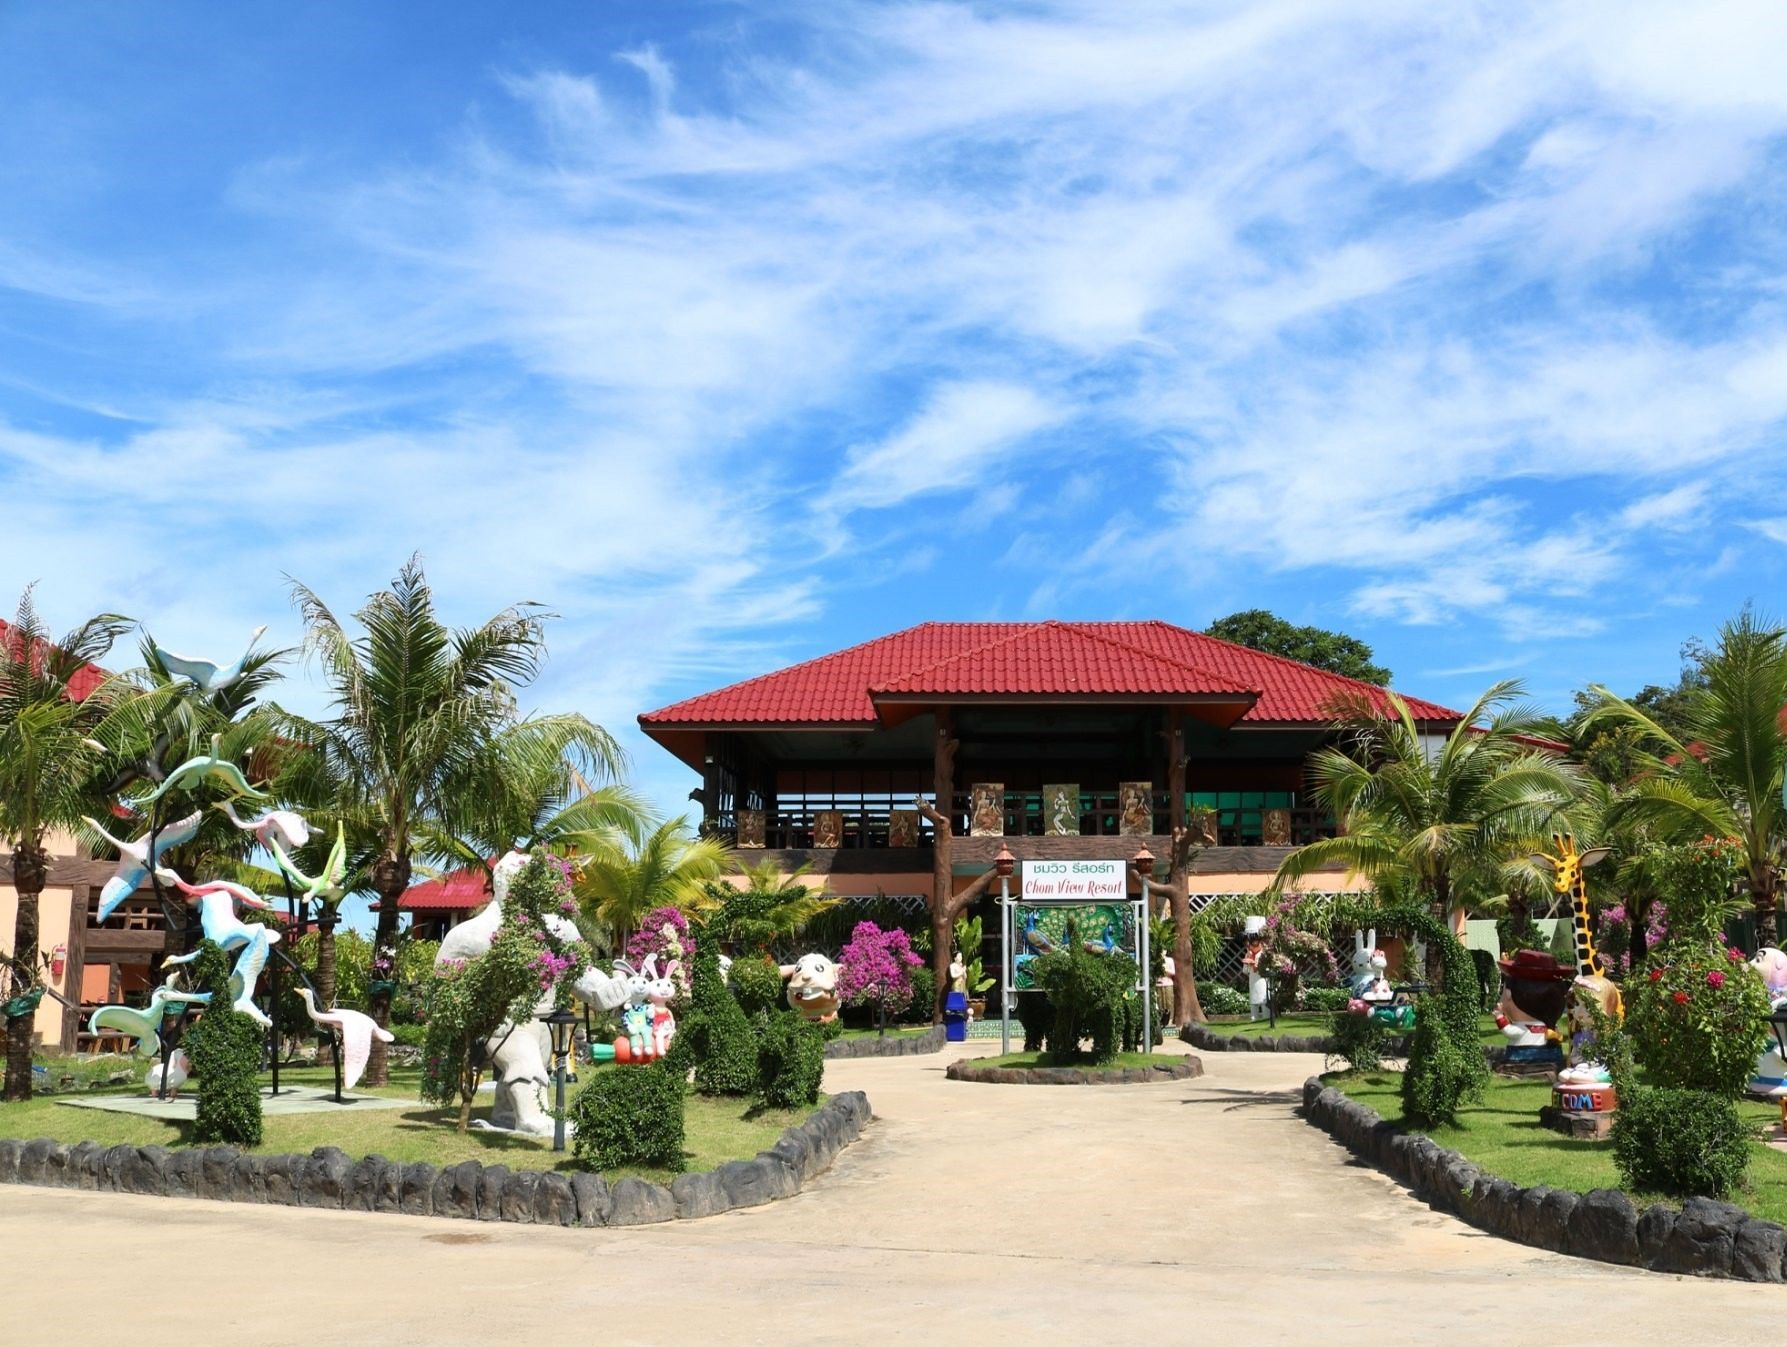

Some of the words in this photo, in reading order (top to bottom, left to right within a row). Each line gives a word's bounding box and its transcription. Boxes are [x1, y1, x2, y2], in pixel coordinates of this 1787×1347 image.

[1025, 879, 1054, 895] Chom
[1057, 879, 1084, 894] View
[1087, 880, 1122, 897] Resort
